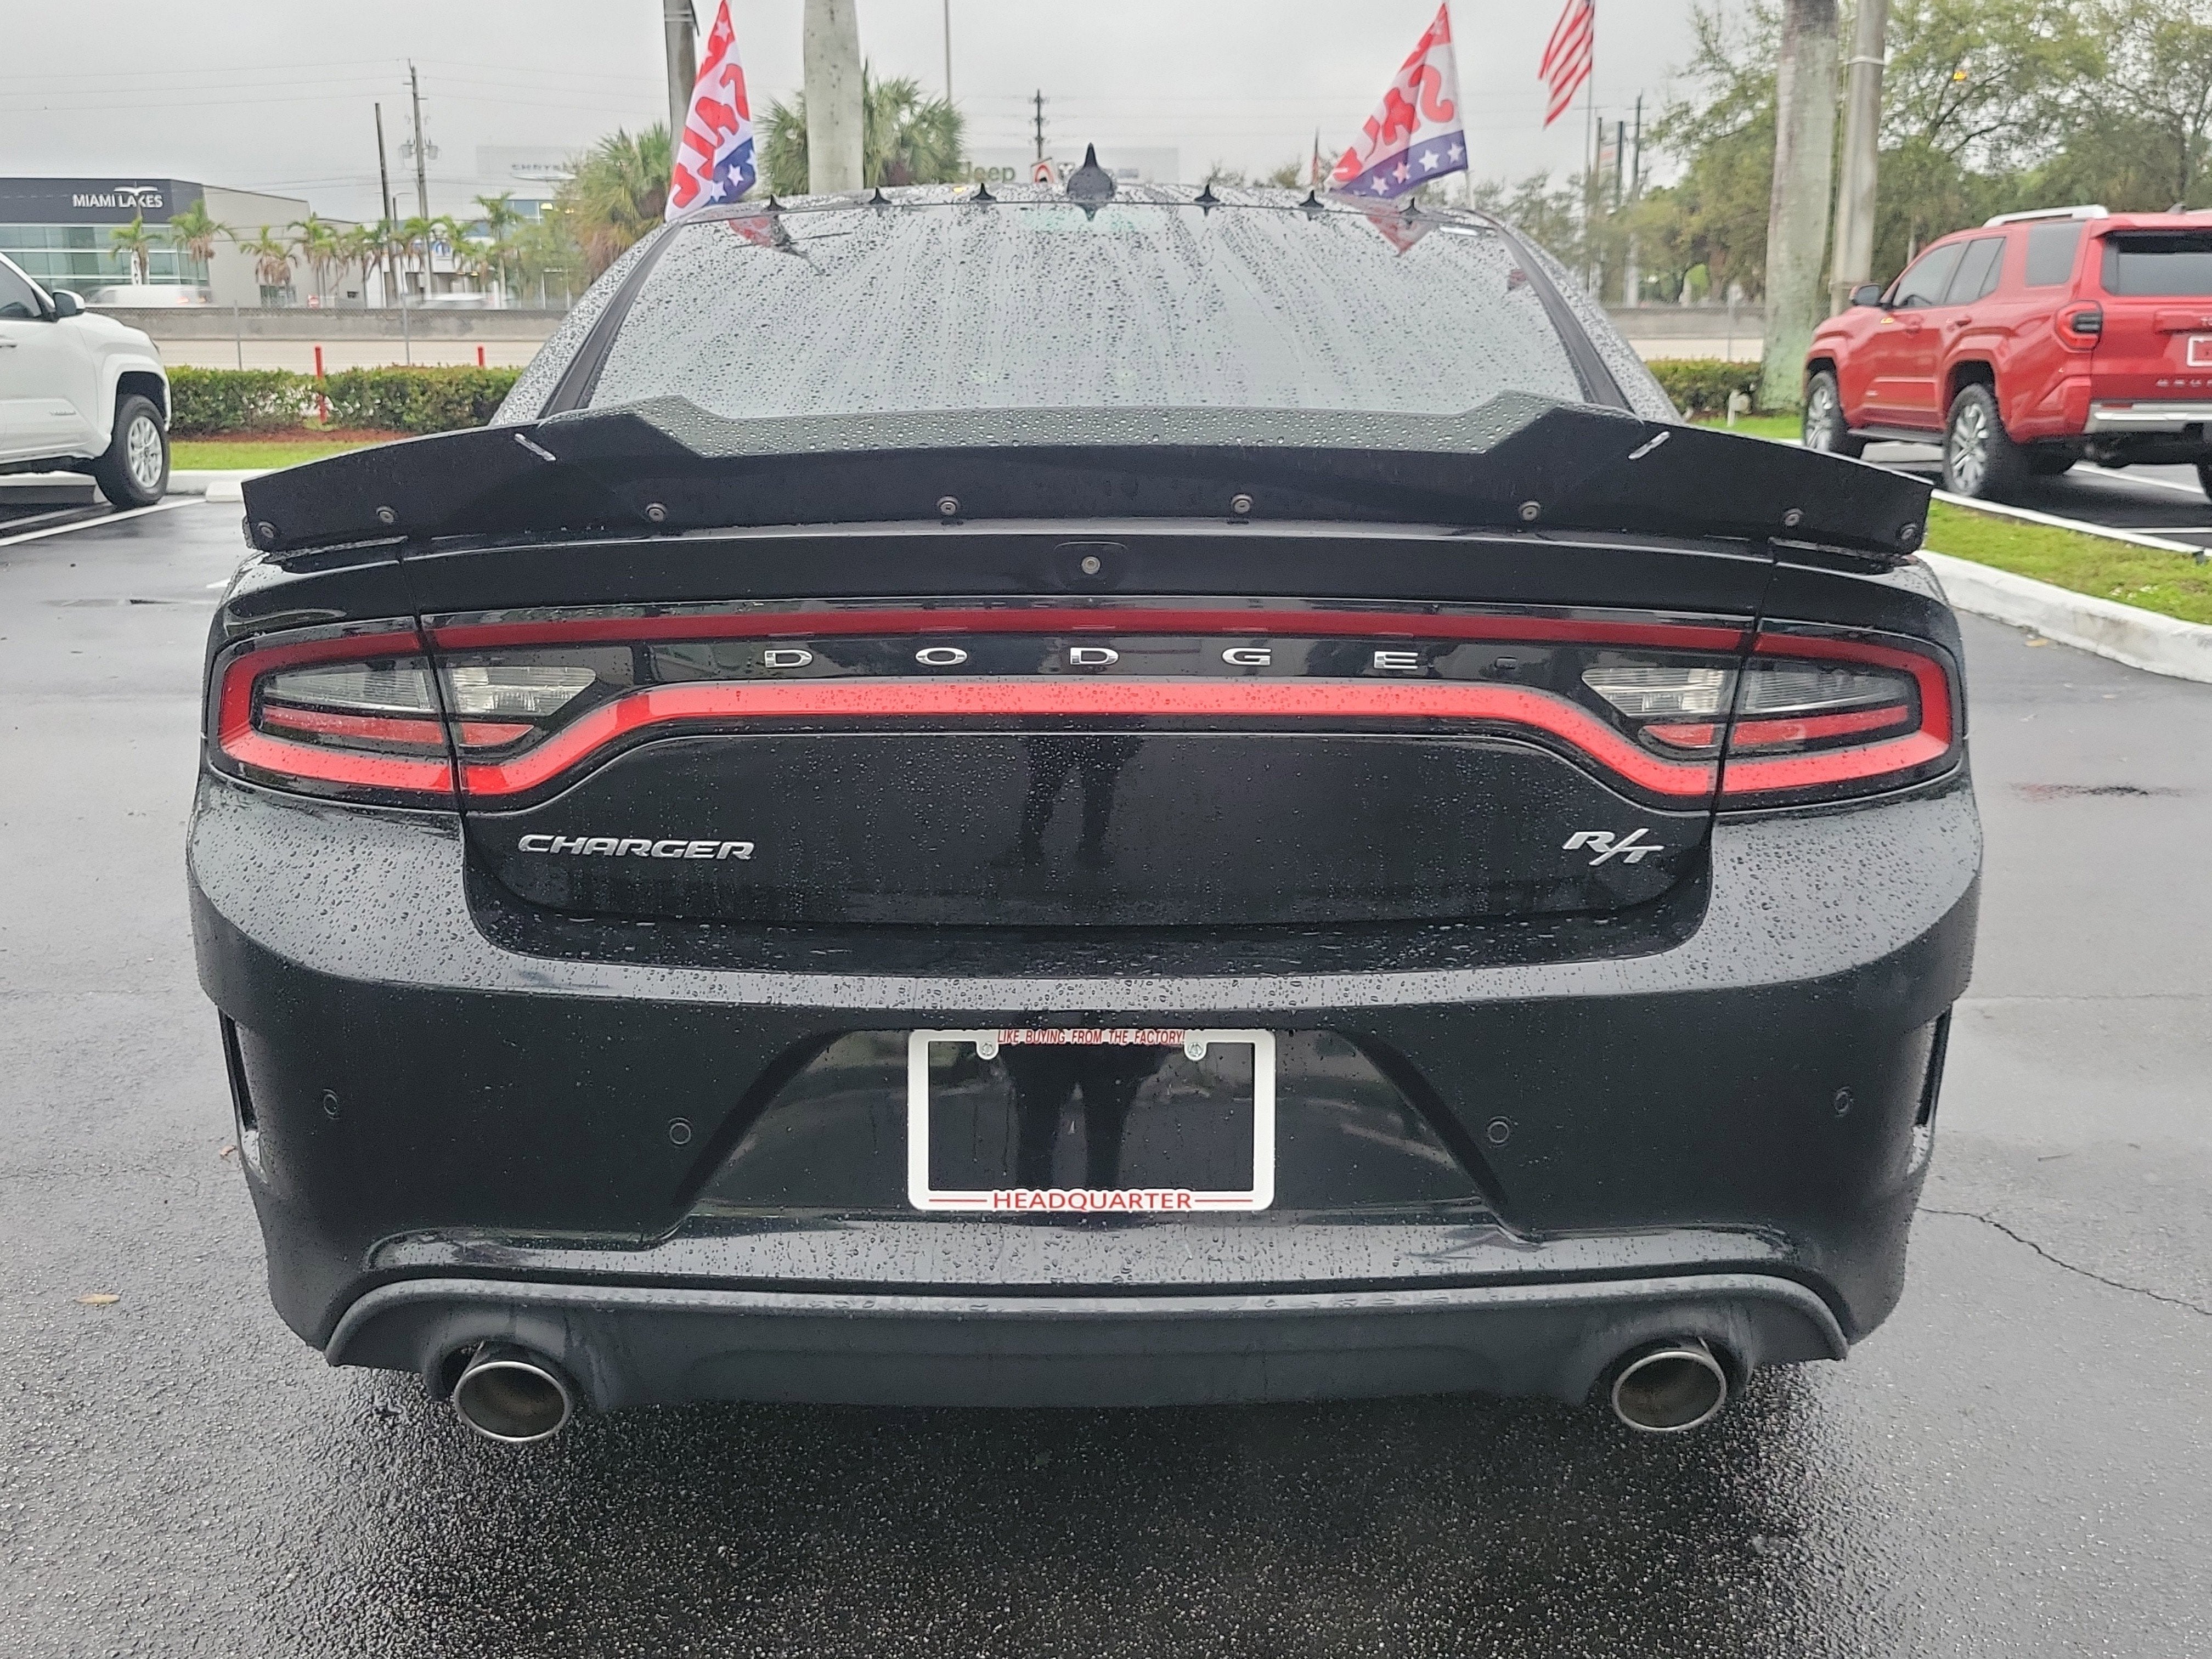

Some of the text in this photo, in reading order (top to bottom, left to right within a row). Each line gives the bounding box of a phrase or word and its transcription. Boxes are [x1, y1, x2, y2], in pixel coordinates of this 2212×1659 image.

[961, 162, 1015, 183] Jeep
[72, 194, 163, 208] MIAMI LAKES
[764, 647, 1419, 670] DODGE
[518, 834, 754, 860] CHARGER
[1562, 828, 1664, 866] R/T
[997, 1030, 1186, 1045] LIKE BUYING FROM THE FACTORY!
[994, 1192, 1192, 1211] HEADQUARTER
